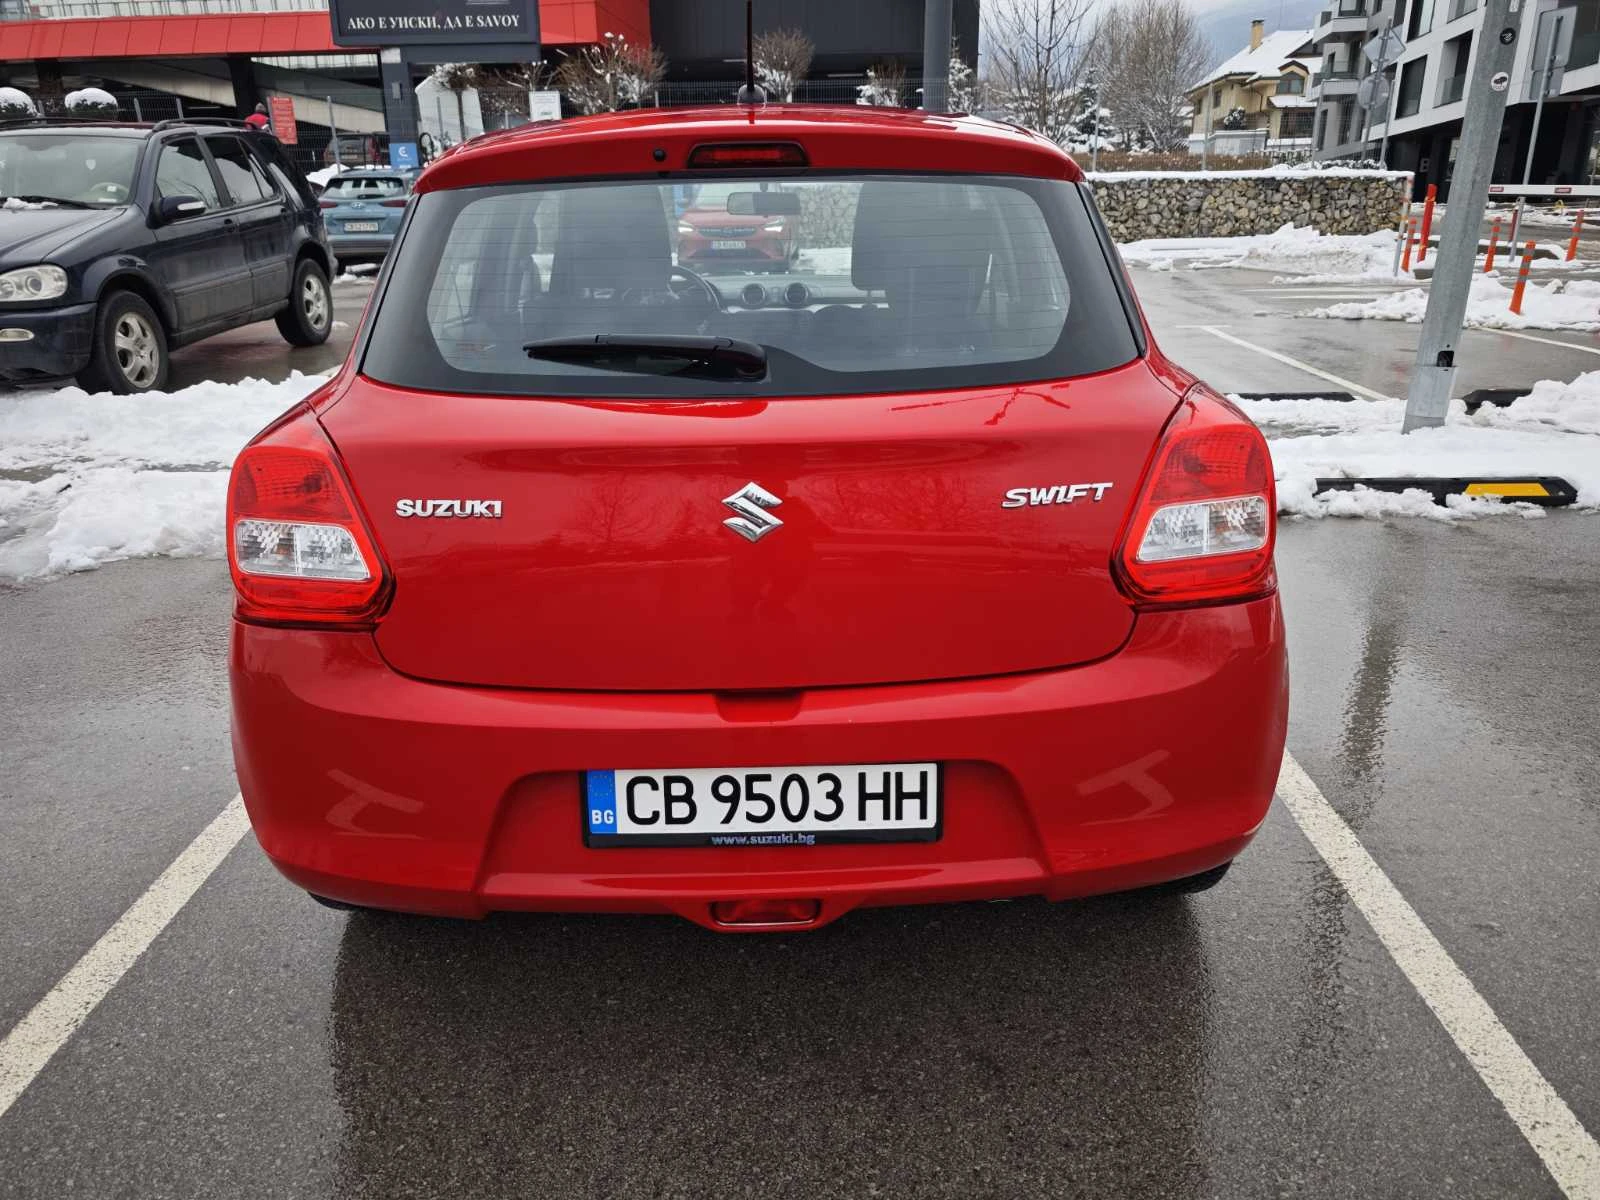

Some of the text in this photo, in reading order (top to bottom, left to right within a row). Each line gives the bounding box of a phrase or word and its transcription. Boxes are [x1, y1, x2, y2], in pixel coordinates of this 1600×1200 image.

[348, 17, 375, 29] АКО
[389, 16, 441, 29] УИСКИ,
[444, 16, 462, 30] ДА
[476, 14, 519, 27] SAVOY
[1001, 482, 1114, 508] SWIFT
[395, 499, 503, 518] SUZUKI
[625, 770, 928, 825] CB 9503 HH
[591, 809, 615, 825] BG
[711, 832, 815, 846] www.suzuki.bg
